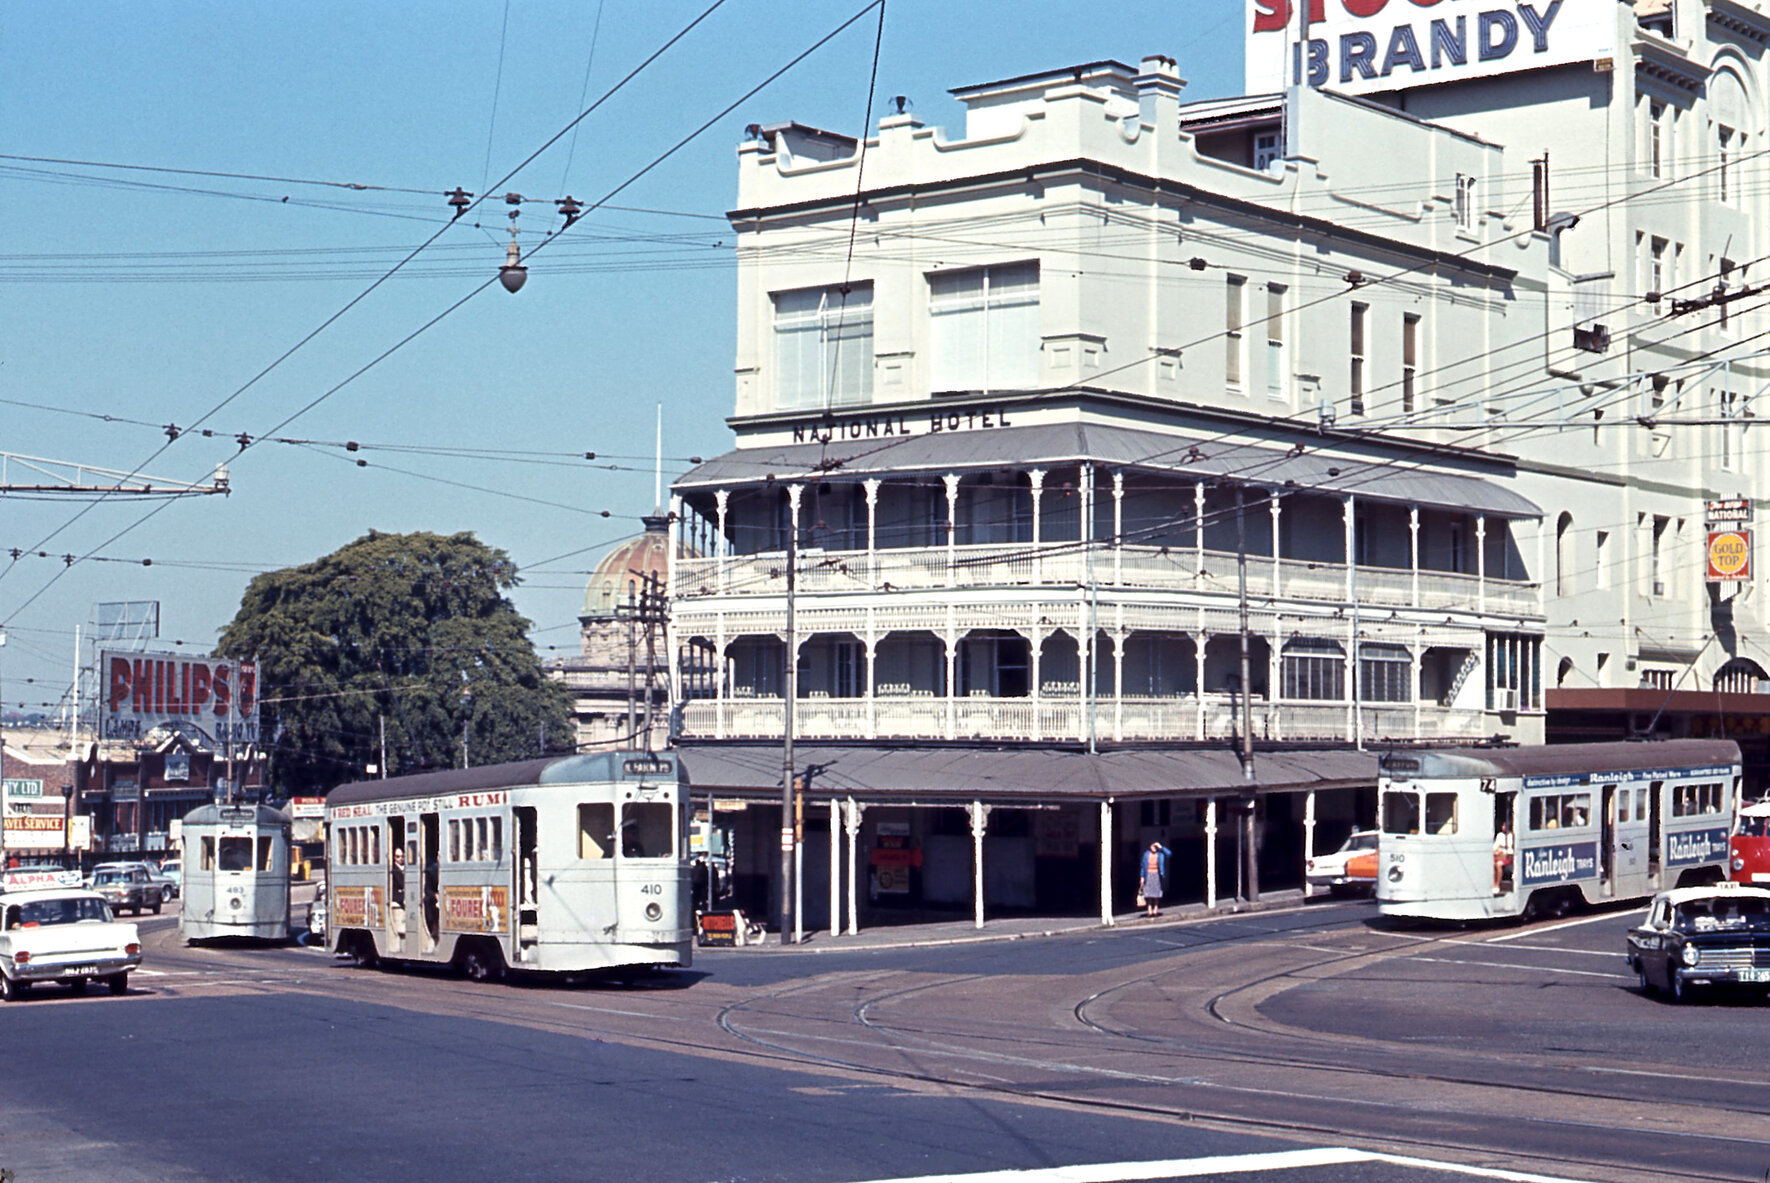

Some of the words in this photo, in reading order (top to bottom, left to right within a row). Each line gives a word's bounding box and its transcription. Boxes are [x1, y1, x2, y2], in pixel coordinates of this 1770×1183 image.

[1293, 0, 1562, 87] BRANDY
[793, 418, 910, 443] NATIONAL
[931, 409, 1011, 433] HOTEL
[1714, 543, 1743, 554] GOLD
[1718, 555, 1740, 566] TOP
[110, 656, 231, 716] PHILIPS
[1590, 771, 1634, 783] Ranleigh
[1481, 780, 1495, 791] 74
[459, 792, 500, 807] RUM
[24, 816, 61, 829] SERVICE
[1669, 832, 1711, 863] Ranleigh
[1390, 853, 1405, 863] 510
[1525, 847, 1575, 880] Ranleigh
[8, 874, 56, 885] ALPHA
[641, 884, 662, 896] 410
